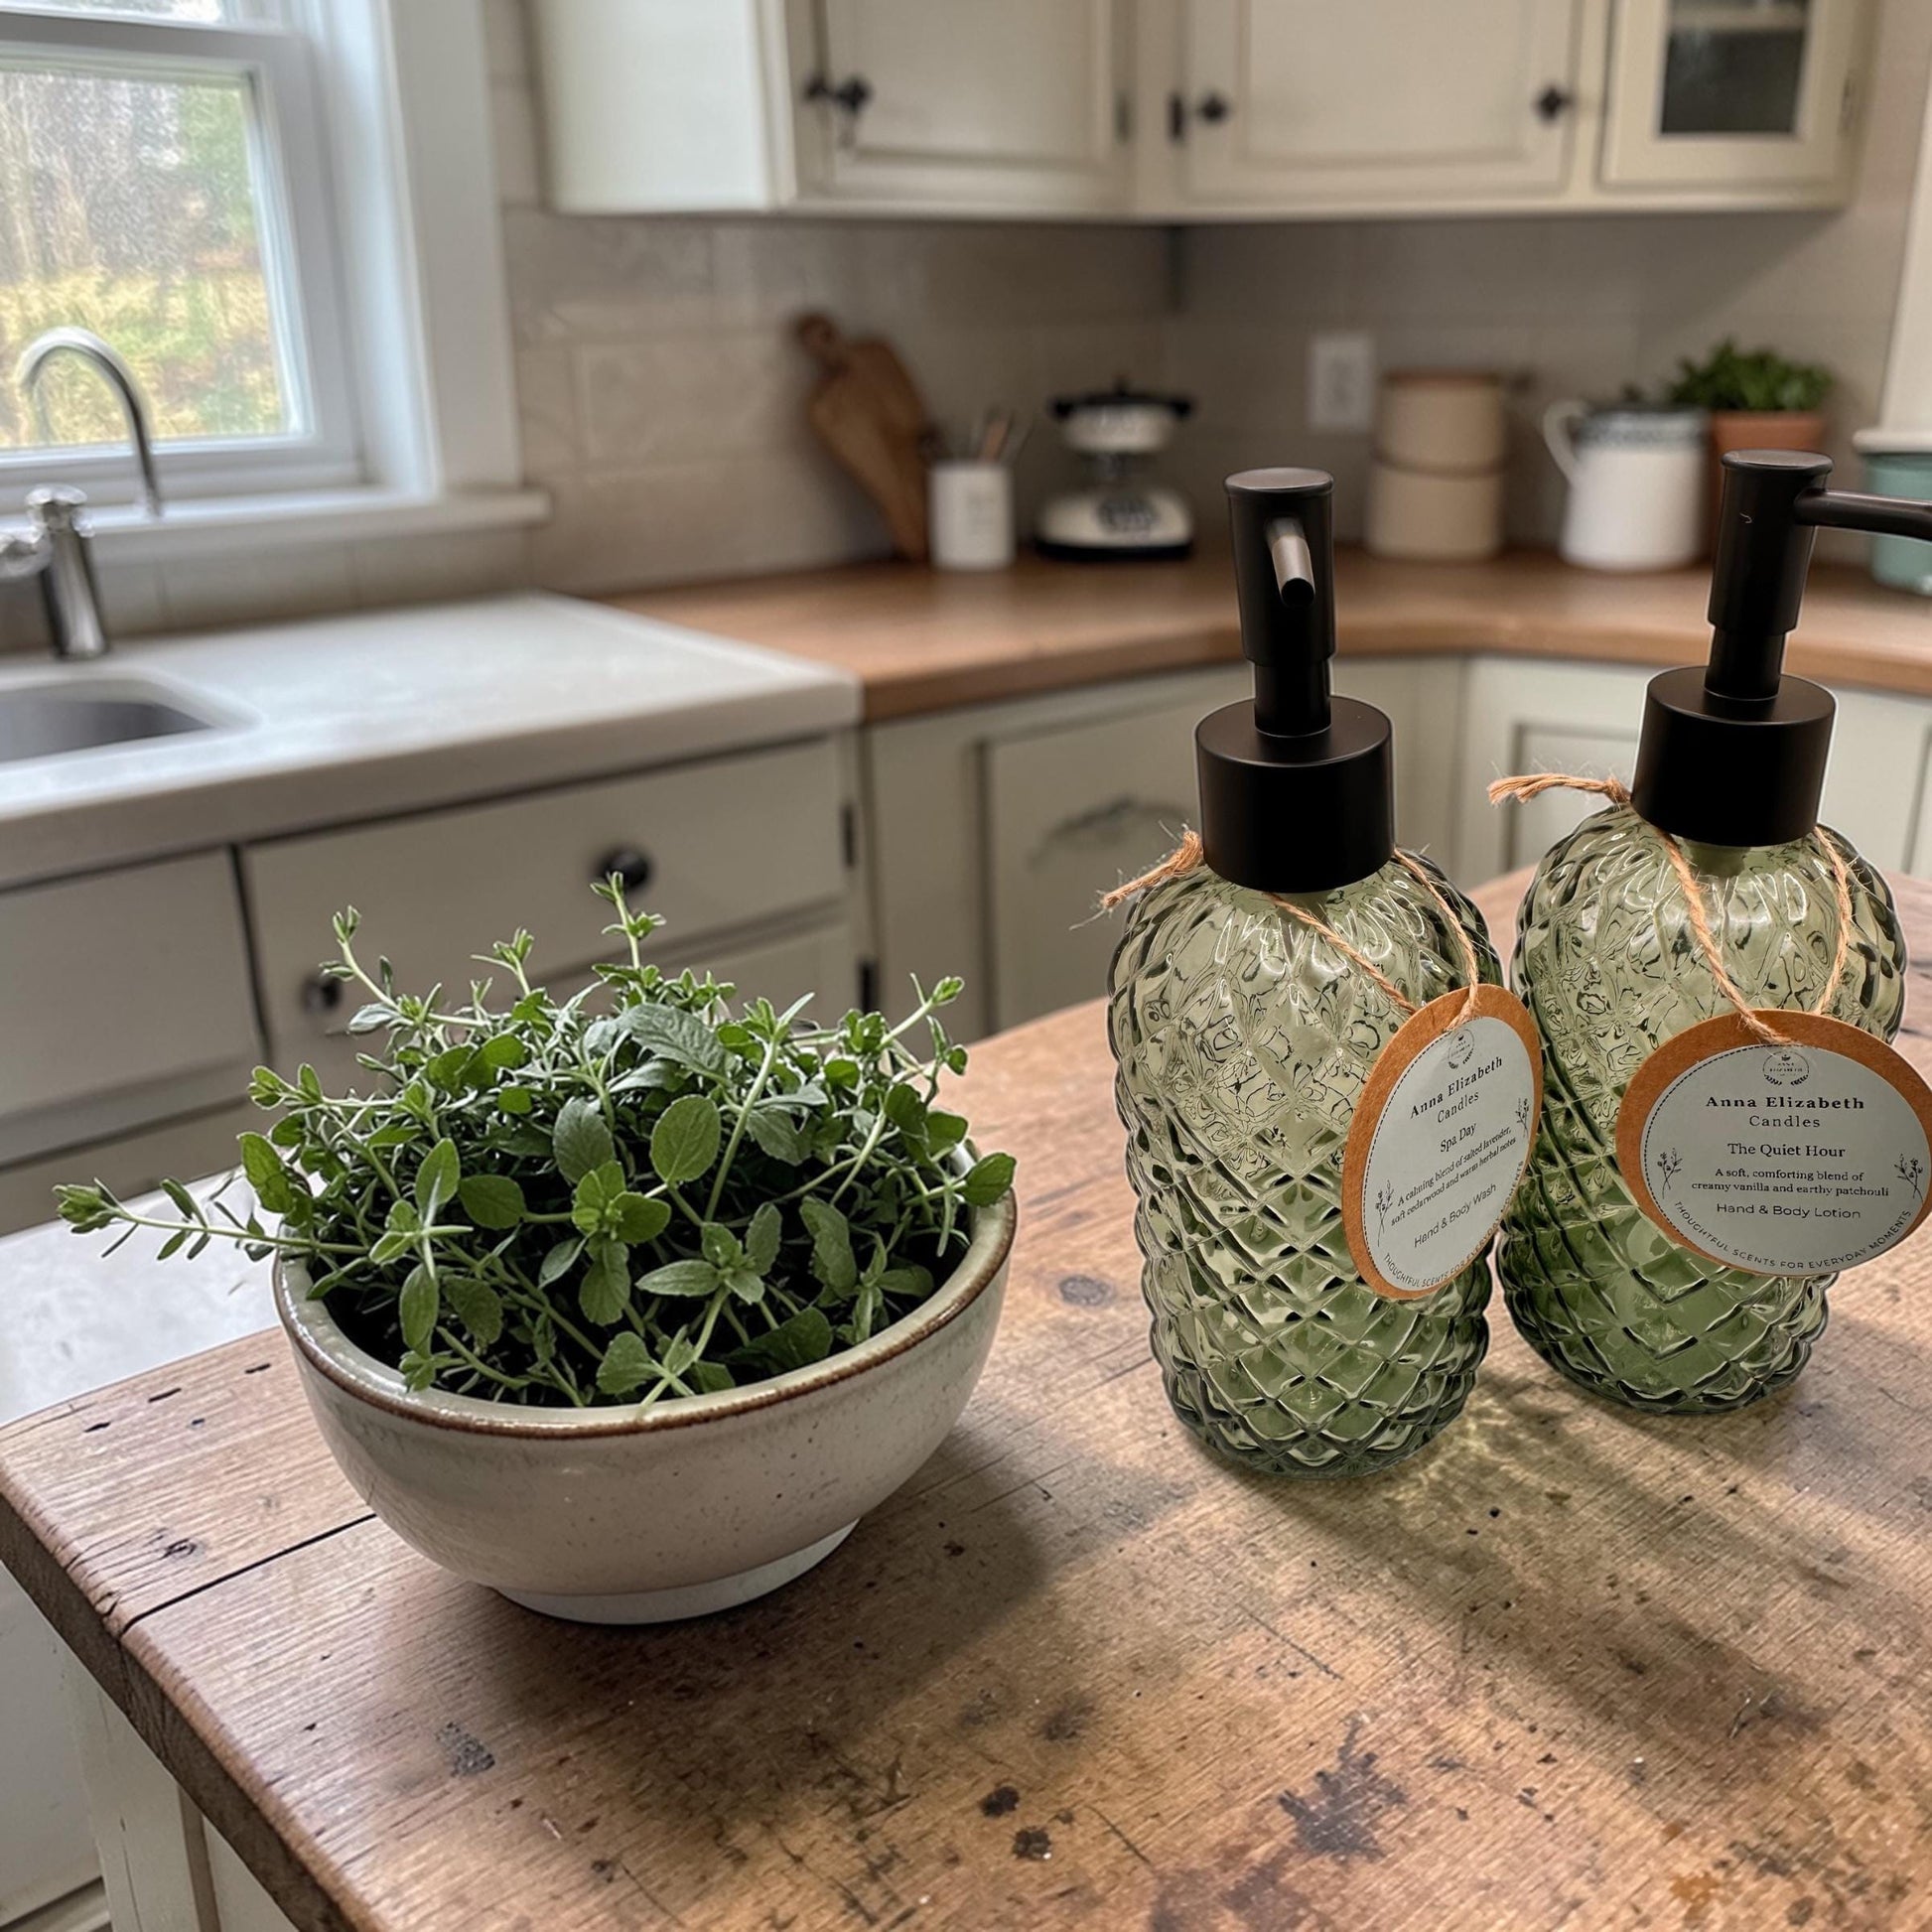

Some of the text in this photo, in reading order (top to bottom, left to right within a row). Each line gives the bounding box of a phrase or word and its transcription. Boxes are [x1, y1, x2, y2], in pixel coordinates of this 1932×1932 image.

[1410, 1056, 1502, 1119] Anna Elizabeth
[1437, 1092, 1479, 1123] Candles
[1706, 1096, 1864, 1110] Anna Elizabeth
[1748, 1115, 1821, 1128] Candles
[1441, 1123, 1476, 1152] Spa Day
[1726, 1143, 1846, 1158] The Quiet Hour
[1446, 1173, 1459, 1189] and
[1459, 1163, 1478, 1178] warm
[1725, 1168, 1749, 1178] soft,
[1752, 1170, 1814, 1181] comforting
[1816, 1171, 1849, 1181] blend
[1852, 1172, 1864, 1181] of
[1691, 1182, 1889, 1197] creamy vanilla and earthy patchouli
[1398, 1196, 1405, 1206] A
[1717, 1202, 1862, 1219] Hand & Body Lotion
[1414, 1222, 1440, 1247] Hand
[1441, 1217, 1448, 1229] &
[1473, 1183, 1496, 1205] Wash
[1674, 1200, 1728, 1252] THOUGHTFUL
[1732, 1249, 1776, 1267] SCENTS
[1808, 1248, 1866, 1269] EVERYDAY
[1868, 1210, 1912, 1250] MOMENTS
[1384, 1253, 1420, 1287] THOUGHTFUL
[1422, 1271, 1449, 1288] SCENTS
